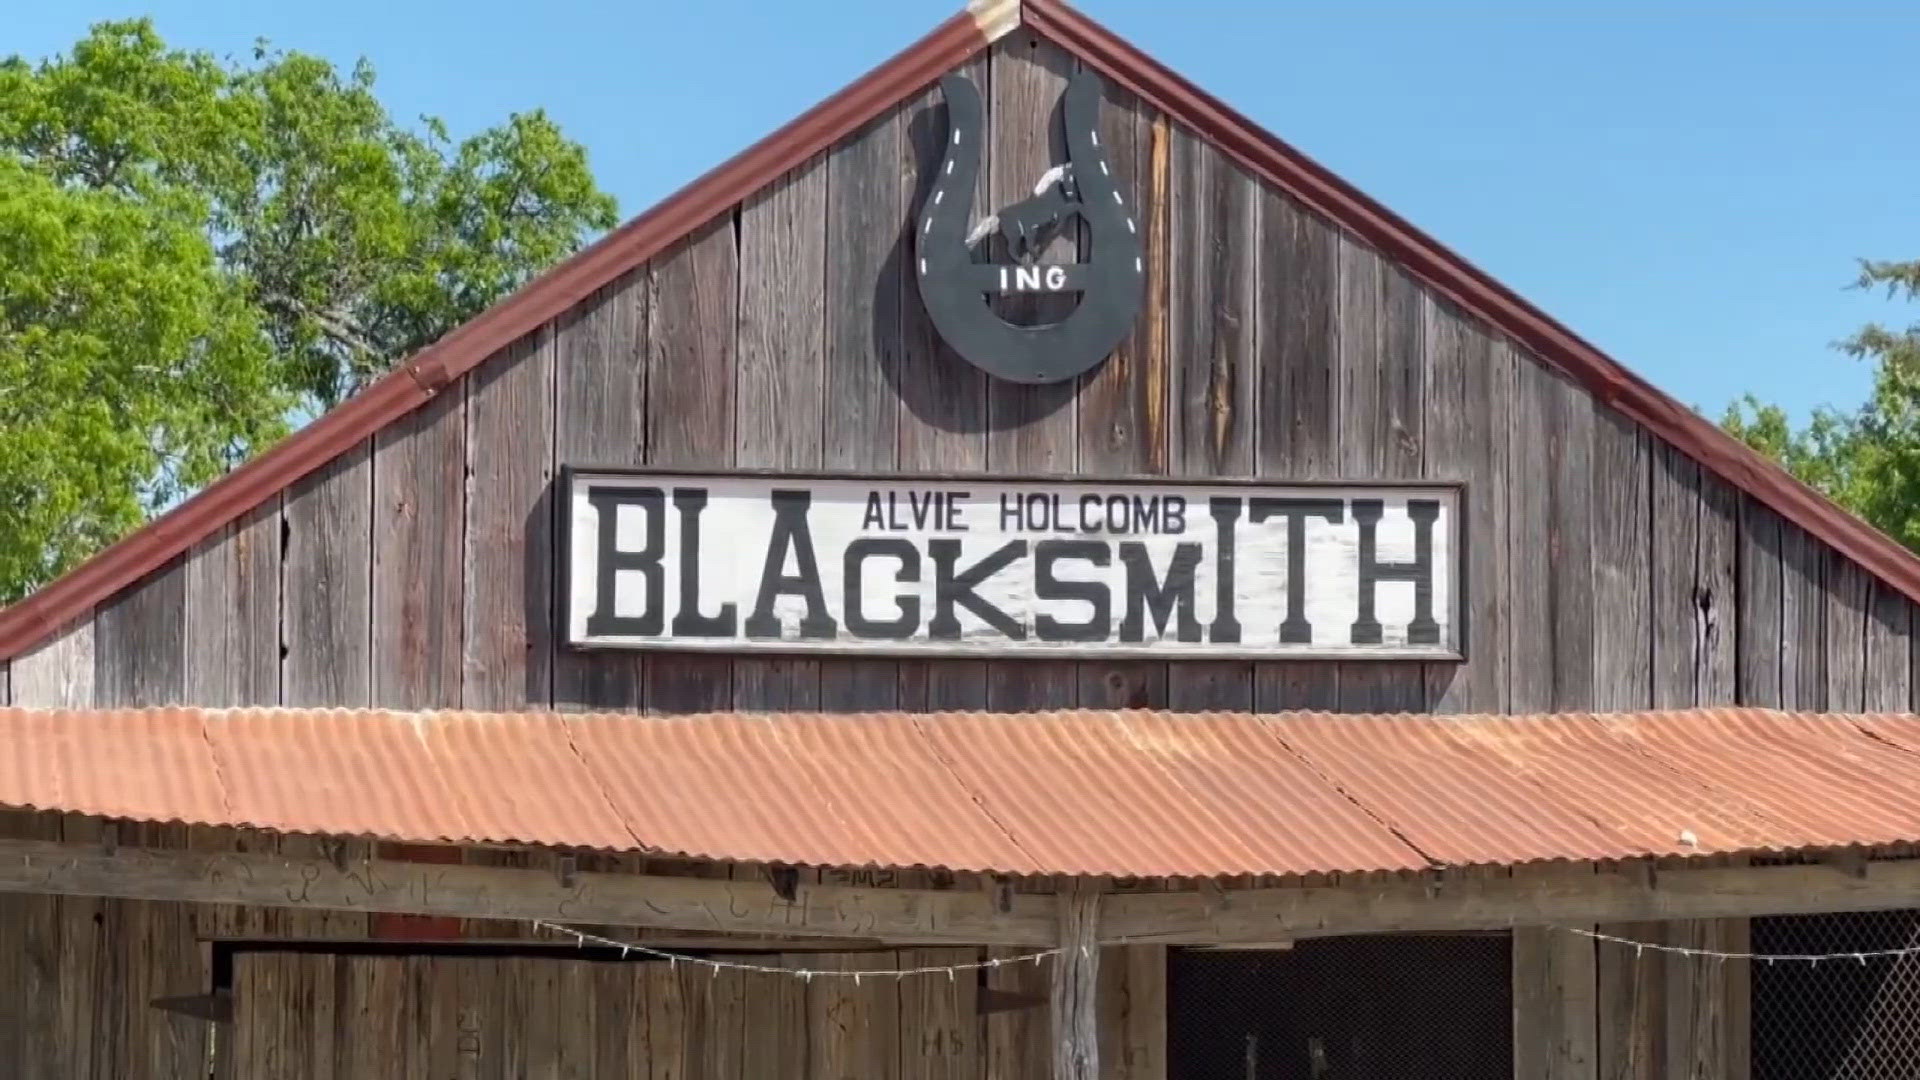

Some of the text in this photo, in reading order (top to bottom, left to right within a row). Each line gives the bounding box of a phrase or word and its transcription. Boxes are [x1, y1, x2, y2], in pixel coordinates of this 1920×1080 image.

[1000, 267, 1067, 291] ING
[863, 491, 1187, 534] ALVIE HOLCOMB
[587, 486, 1440, 643] BLACKSMITH
